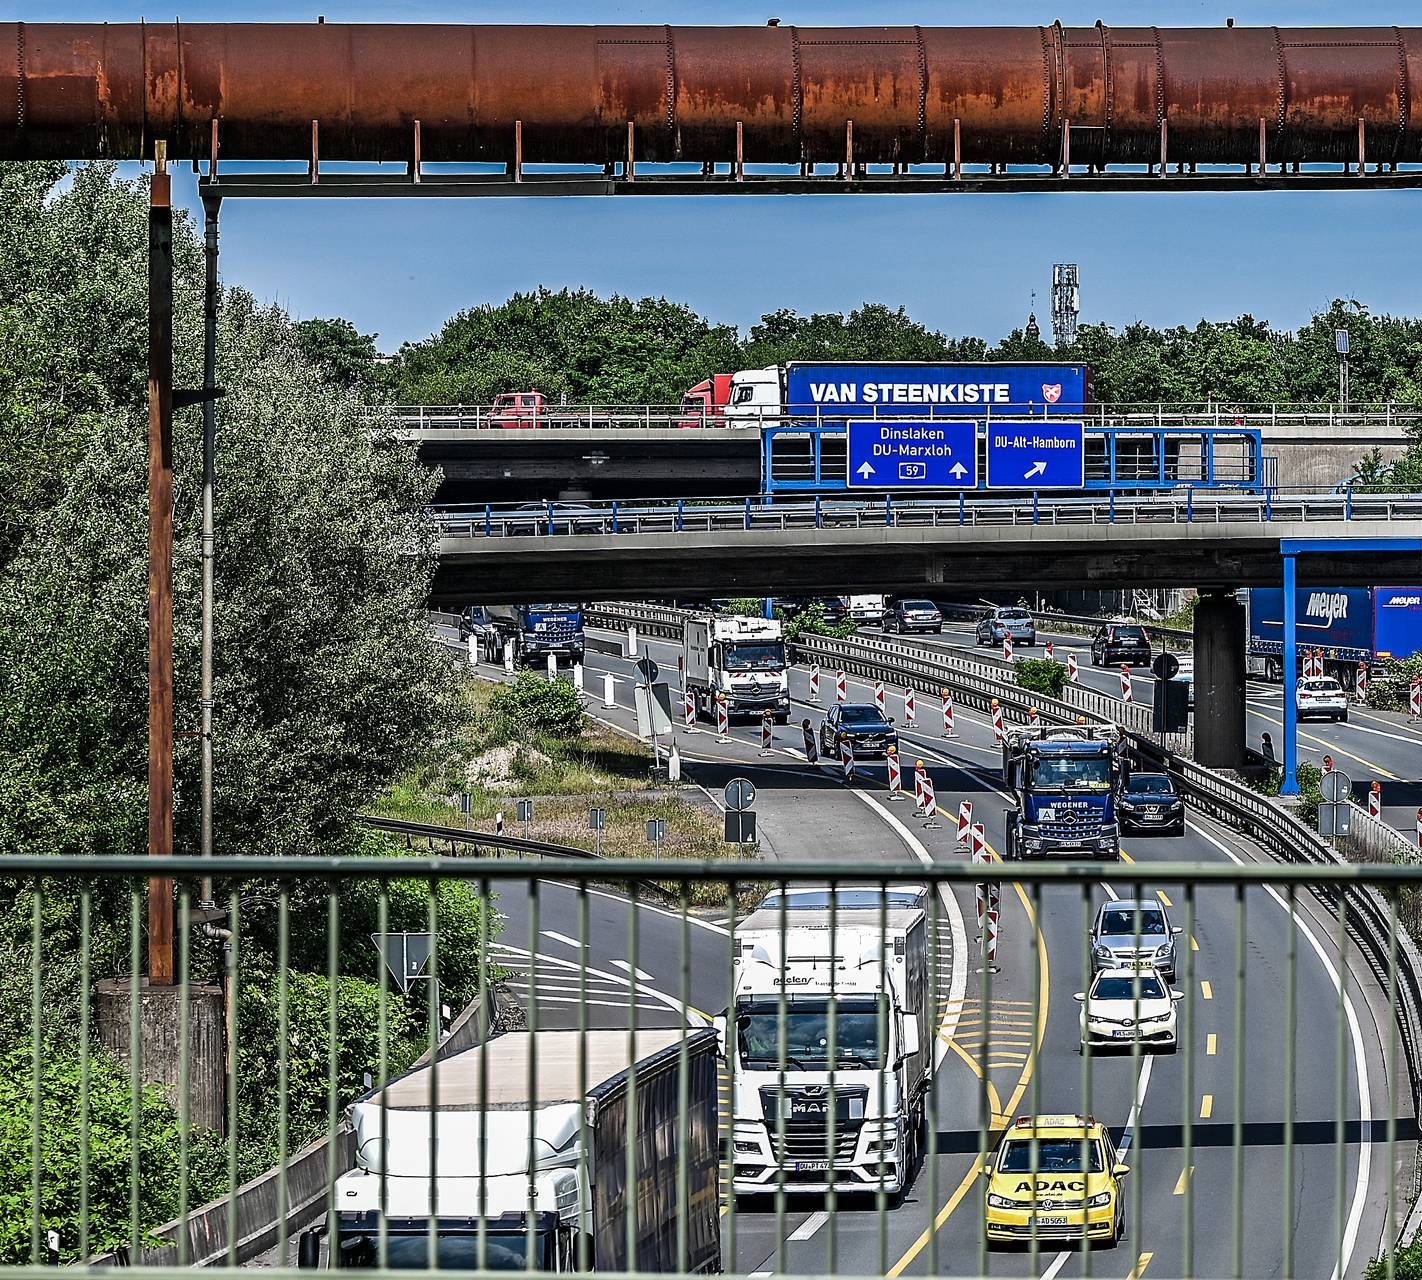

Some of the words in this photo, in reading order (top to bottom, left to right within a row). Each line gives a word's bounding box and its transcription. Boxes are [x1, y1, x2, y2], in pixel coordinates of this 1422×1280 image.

[810, 384, 858, 404] VAN
[863, 384, 1010, 403] STEENKISTE
[880, 427, 944, 440] Dinslaken
[995, 435, 1076, 449] DU-Alt-Hamborn
[873, 443, 952, 456] DU-Marxloh
[906, 465, 919, 476] 59
[1050, 801, 1088, 809] WEGENER
[1042, 810, 1053, 819] A
[1014, 1181, 1086, 1193] ADAC
